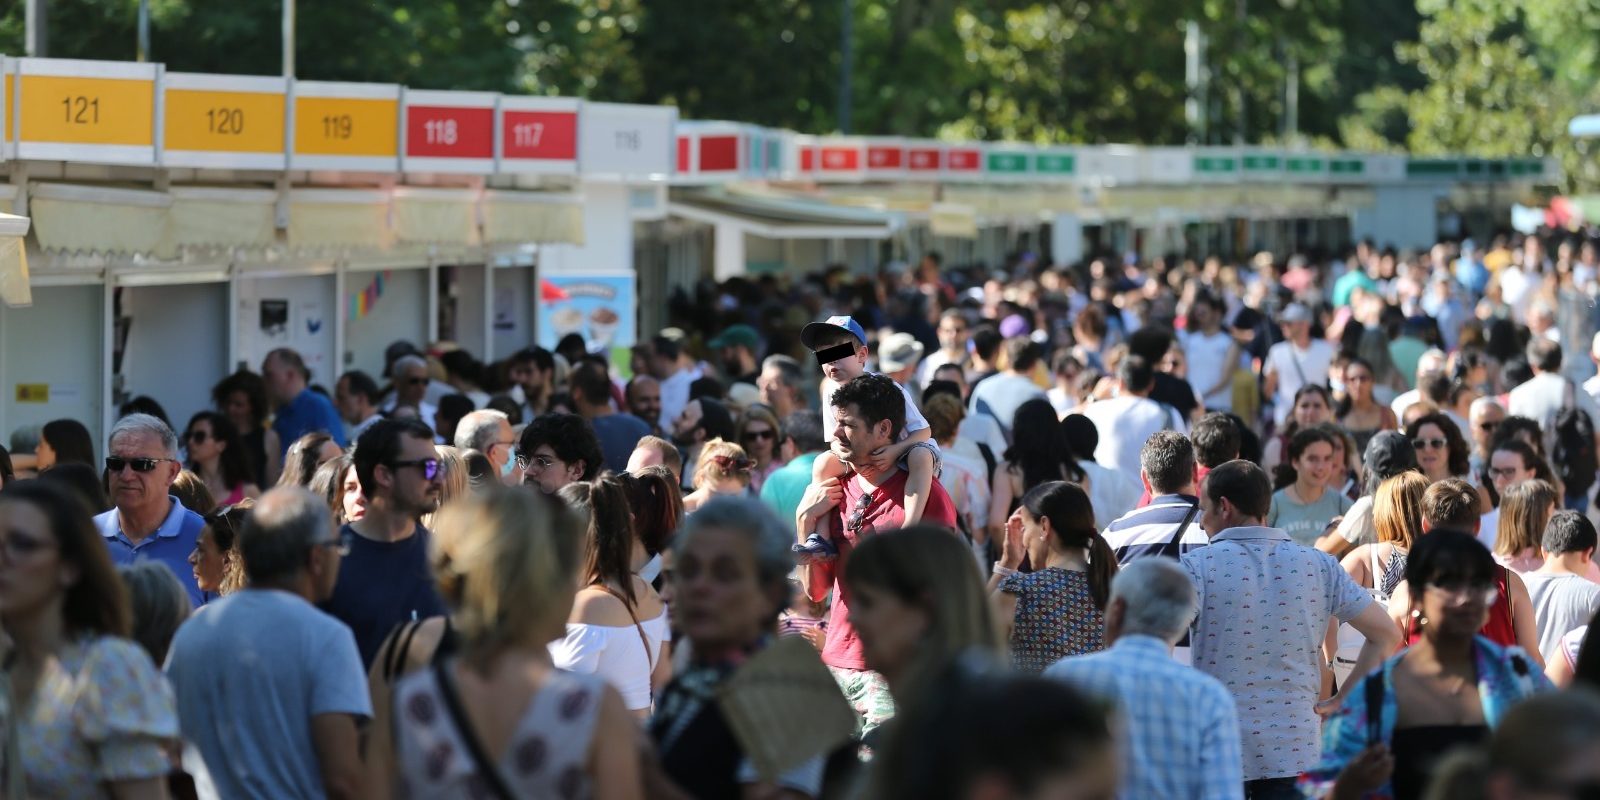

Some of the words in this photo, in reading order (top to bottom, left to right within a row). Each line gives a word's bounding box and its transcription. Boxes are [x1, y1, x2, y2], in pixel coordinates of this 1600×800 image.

[62, 96, 98, 124] 121
[206, 107, 244, 135] 120
[322, 114, 352, 140] 119
[423, 119, 457, 145] 118
[512, 122, 544, 147] 117
